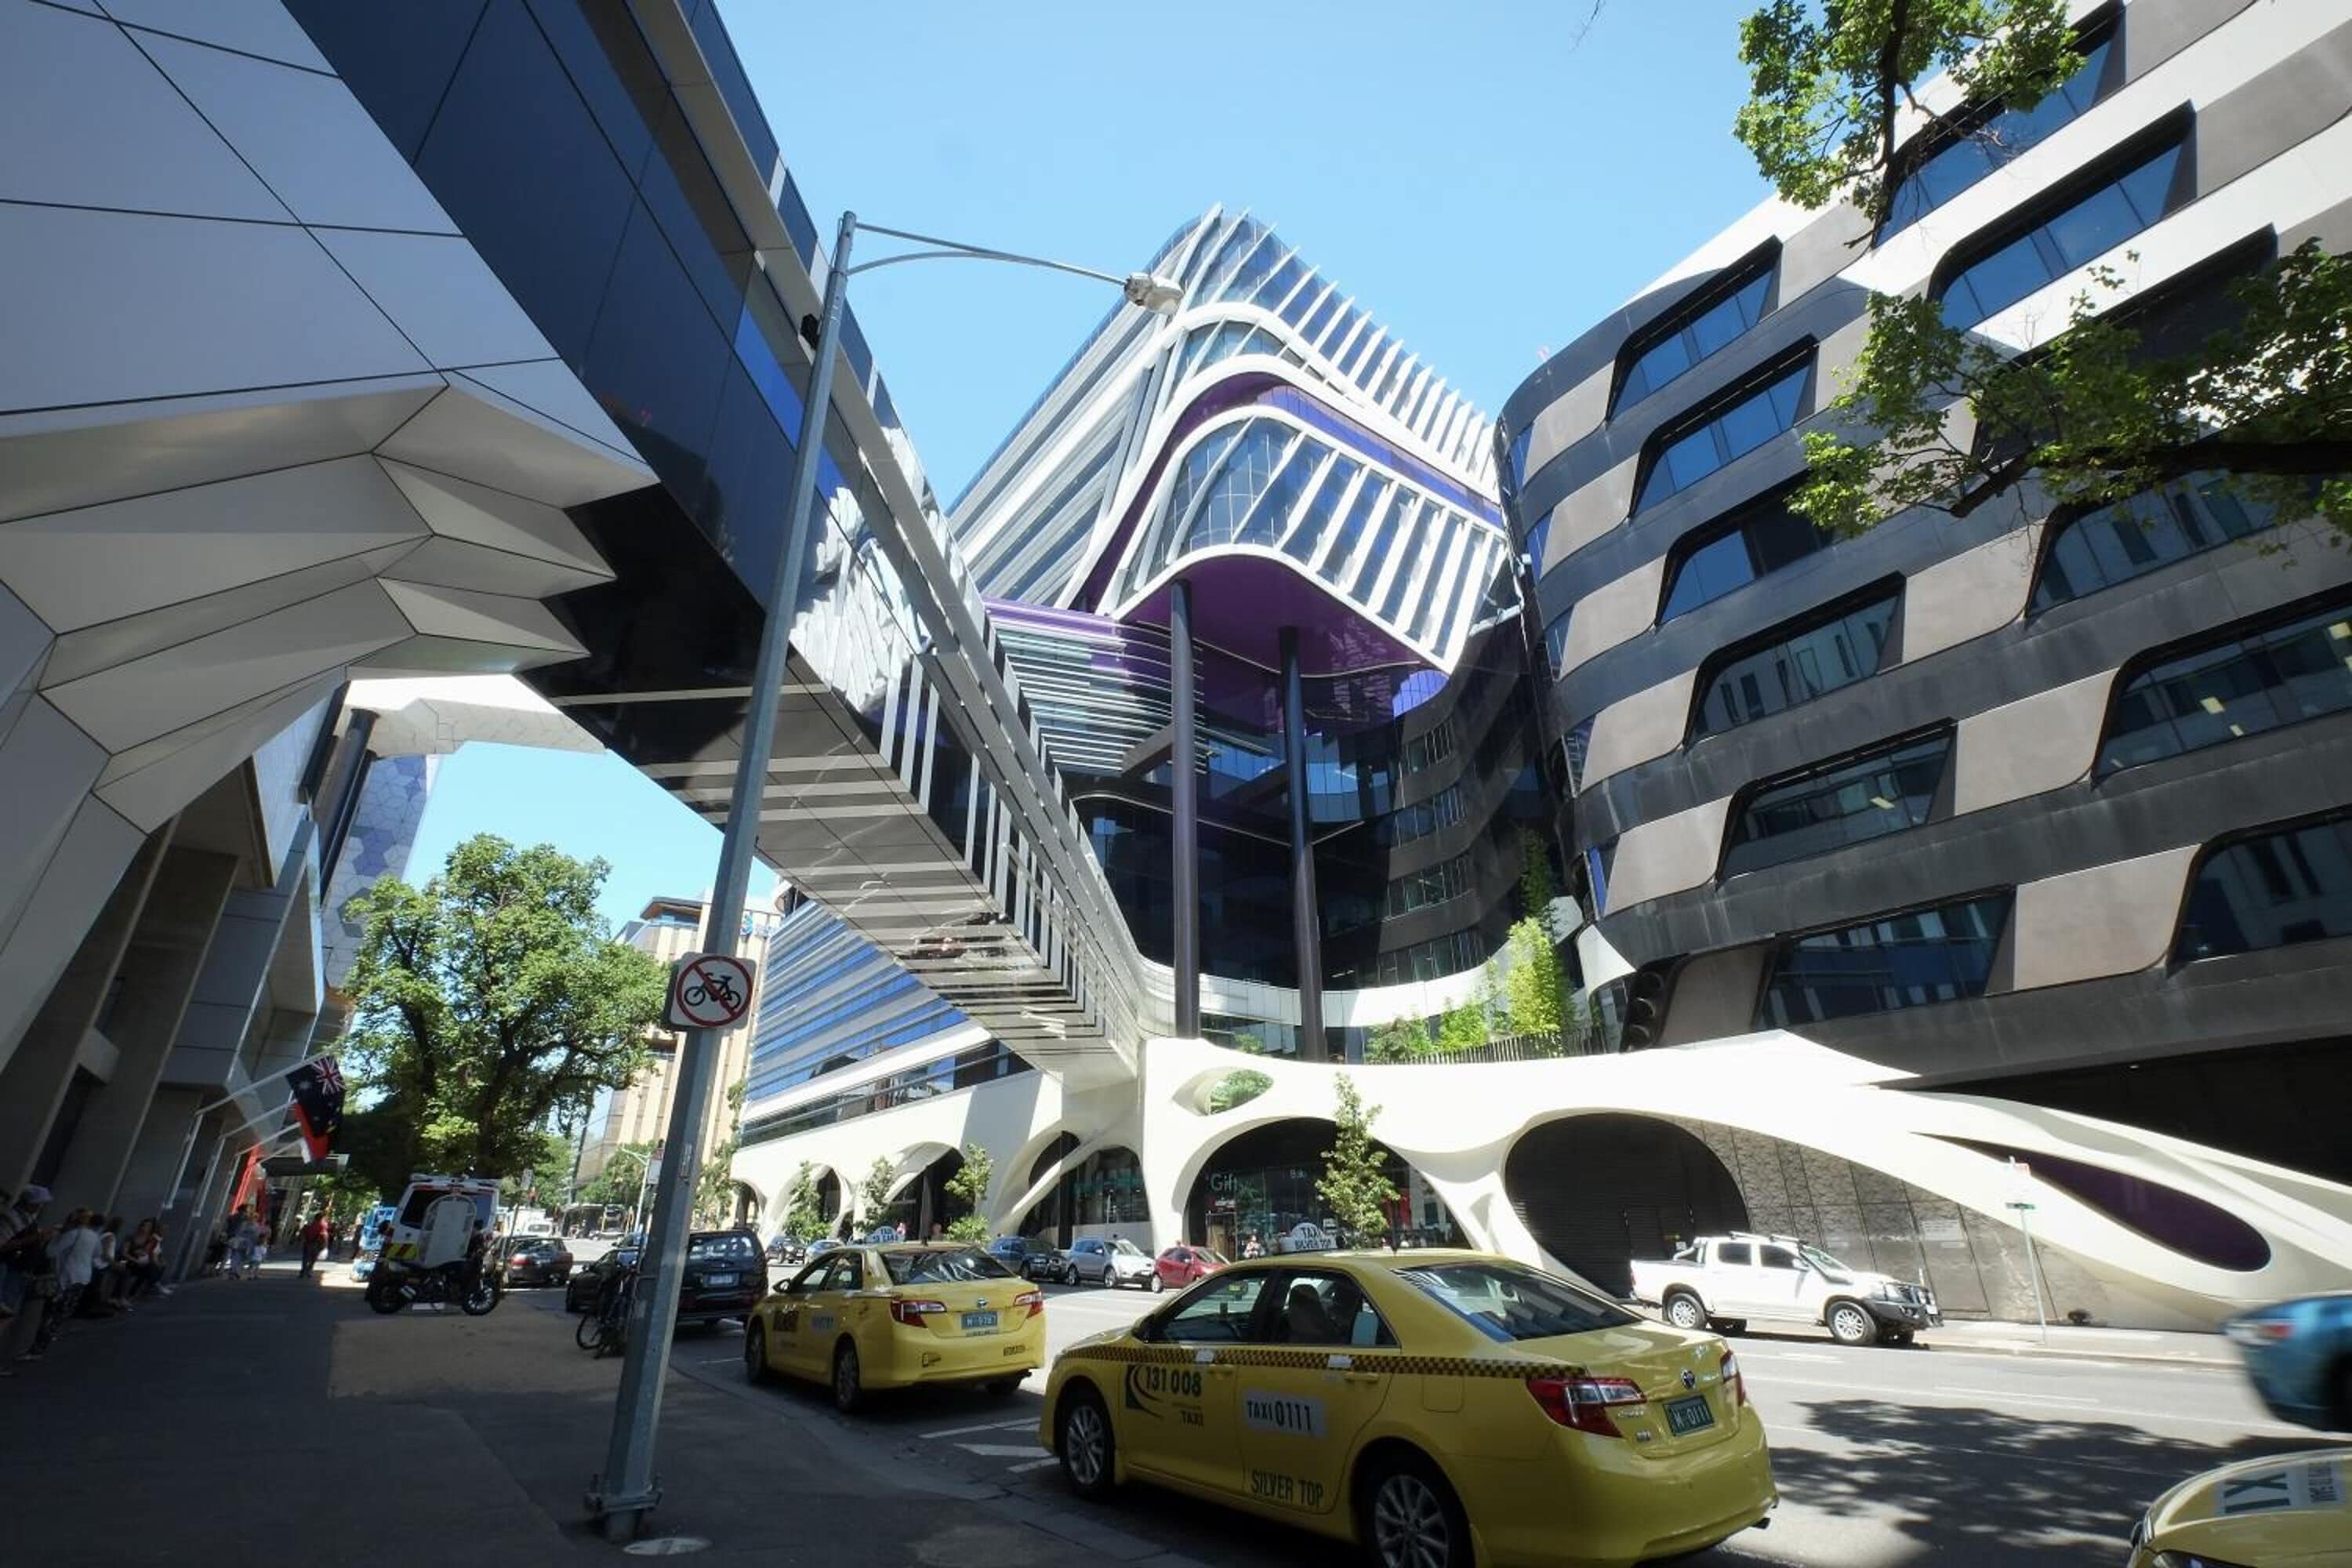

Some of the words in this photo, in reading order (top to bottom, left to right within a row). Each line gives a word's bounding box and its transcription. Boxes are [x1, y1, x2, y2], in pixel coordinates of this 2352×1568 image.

[1145, 1366, 1167, 1392] 131
[1171, 1370, 1202, 1398] 008
[1179, 1410, 1204, 1427] TAXI
[1247, 1399, 1273, 1421] TAXI
[1275, 1400, 1312, 1431] 0111
[1251, 1468, 1294, 1502] SILVER
[1298, 1479, 1324, 1508] TOP
